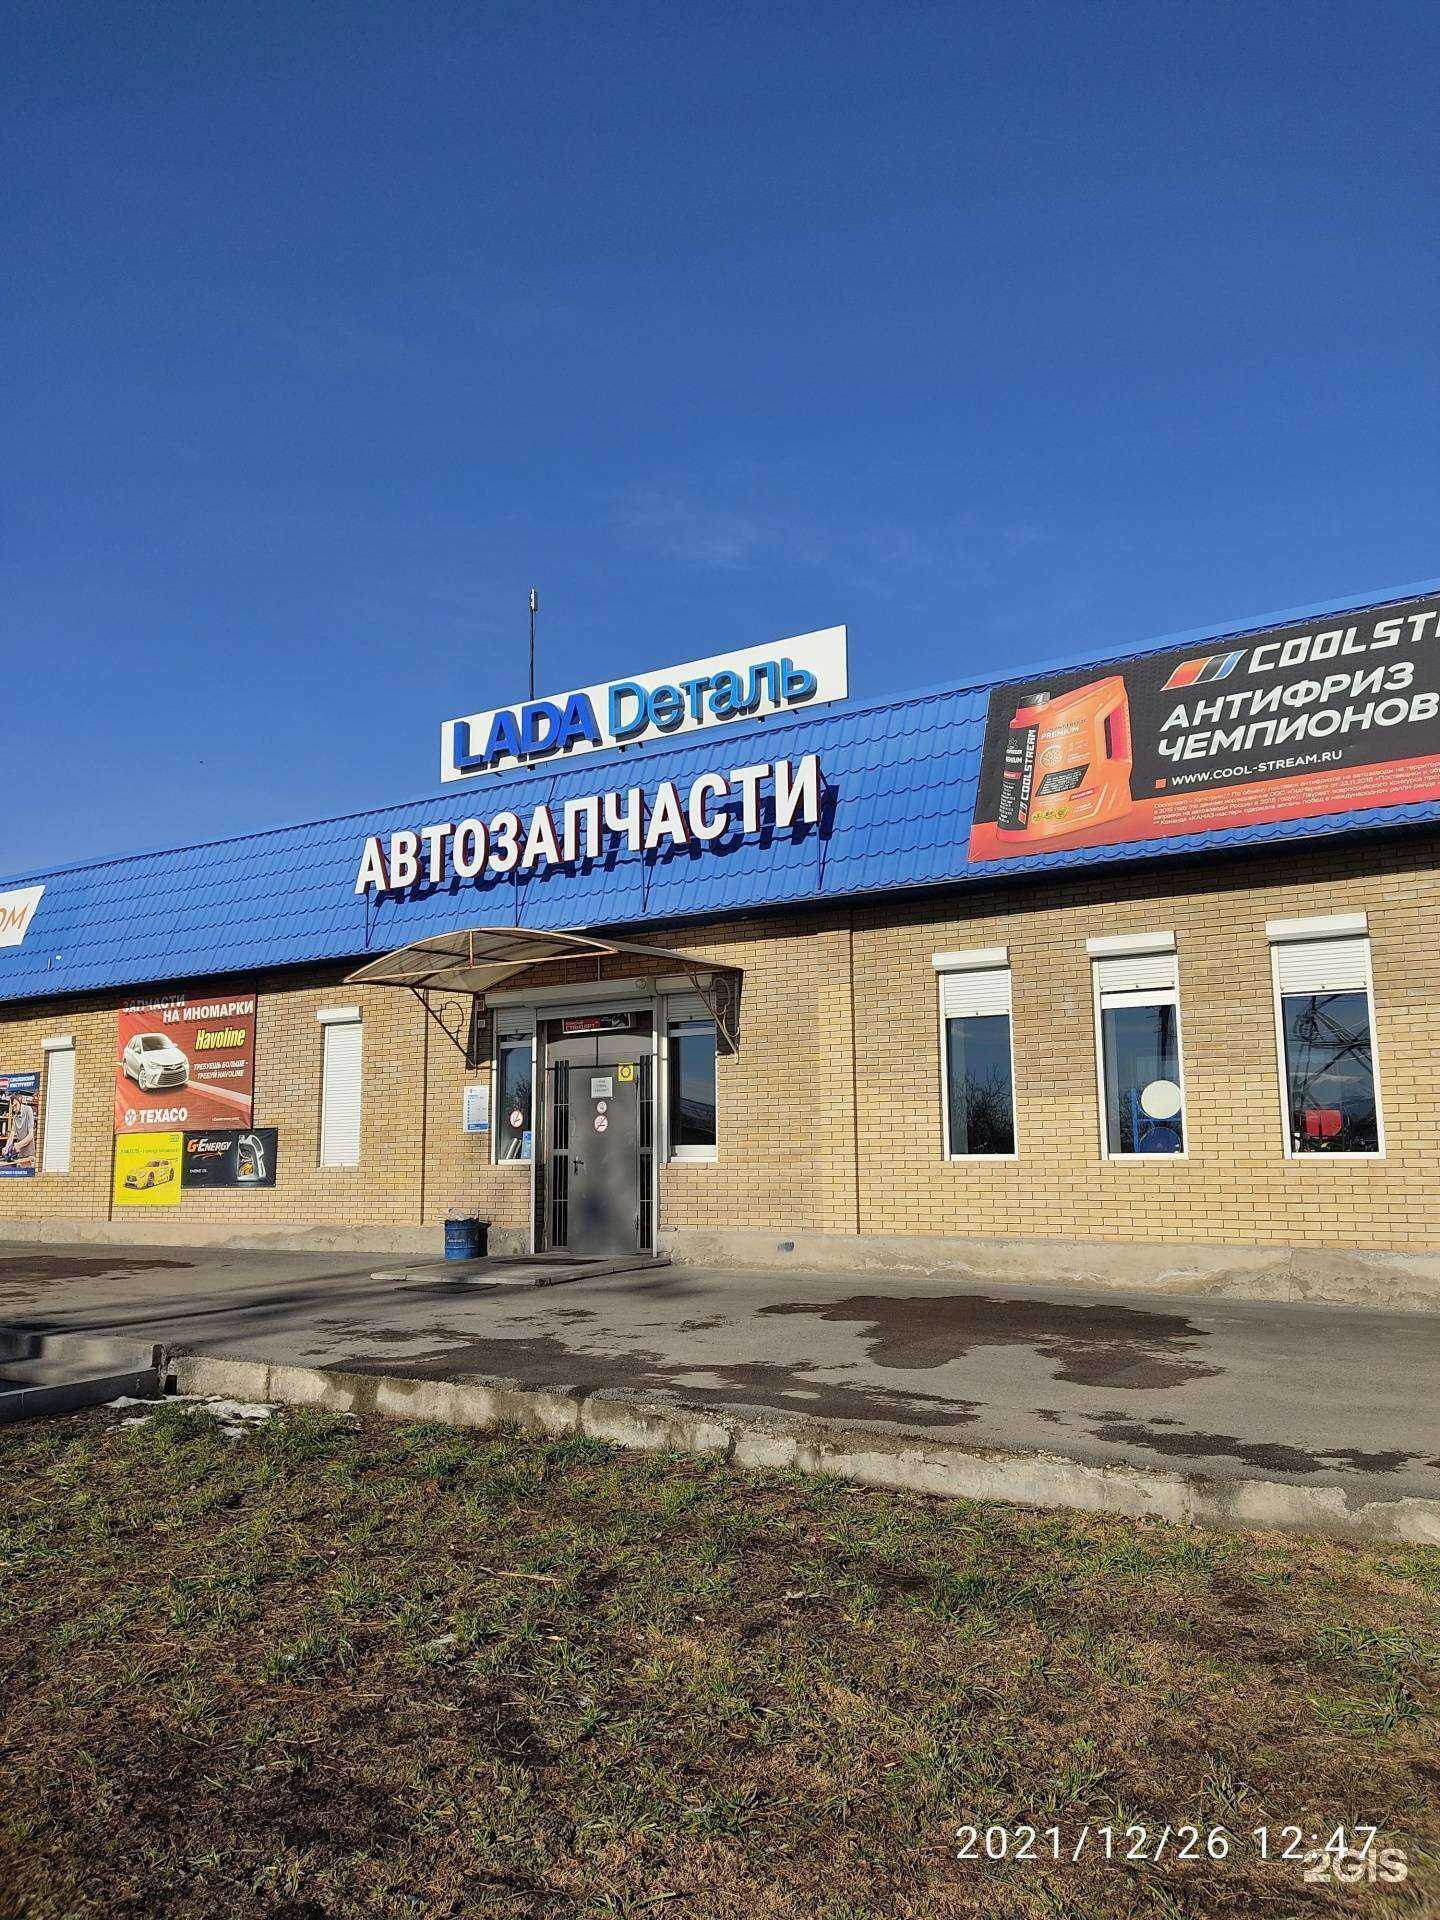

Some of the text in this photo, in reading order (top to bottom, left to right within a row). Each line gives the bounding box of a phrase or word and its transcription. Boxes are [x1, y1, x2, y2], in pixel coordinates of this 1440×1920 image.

[1248, 610, 1440, 674] COOLST
[1161, 661, 1415, 732] АНТИФРИЗ
[453, 694, 602, 773] LADA
[1041, 726, 1080, 740] PREMIUM
[1158, 692, 1440, 762] ЧЕМПИОНОВ
[1020, 729, 1037, 801] COOLSTREAM
[1171, 750, 1342, 786] WWW.COOL-STREAM.RU
[355, 755, 822, 895] АВТОЗАПЧАСТИ
[122, 995, 185, 1012] ЗАПЧАСТИ
[163, 1001, 253, 1023] НА ИНОМАРКИ
[195, 1027, 246, 1050] Havoline
[139, 1108, 188, 1123] TEXACO
